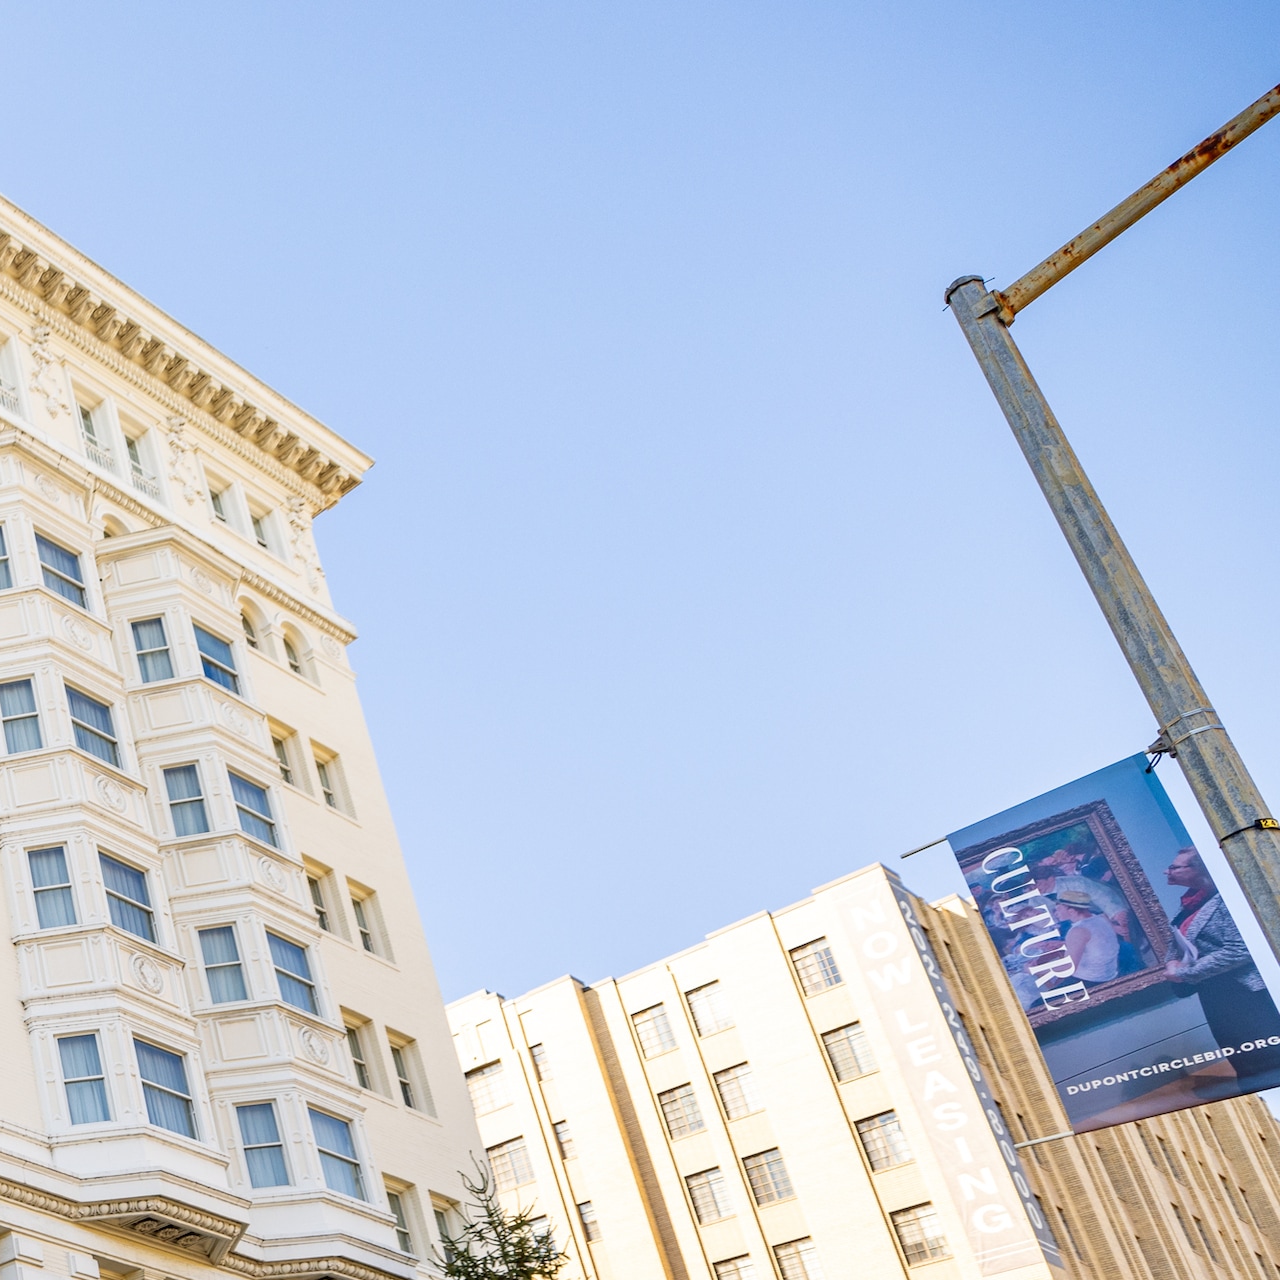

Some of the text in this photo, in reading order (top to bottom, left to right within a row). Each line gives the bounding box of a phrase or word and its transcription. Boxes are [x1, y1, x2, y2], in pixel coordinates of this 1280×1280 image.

[849, 900, 912, 993] NOW
[981, 846, 1090, 1011] CULTURE
[895, 1009, 1016, 1234] LEASING
[1066, 1035, 1280, 1096] DUPONTCIRCLEBID.ORG
